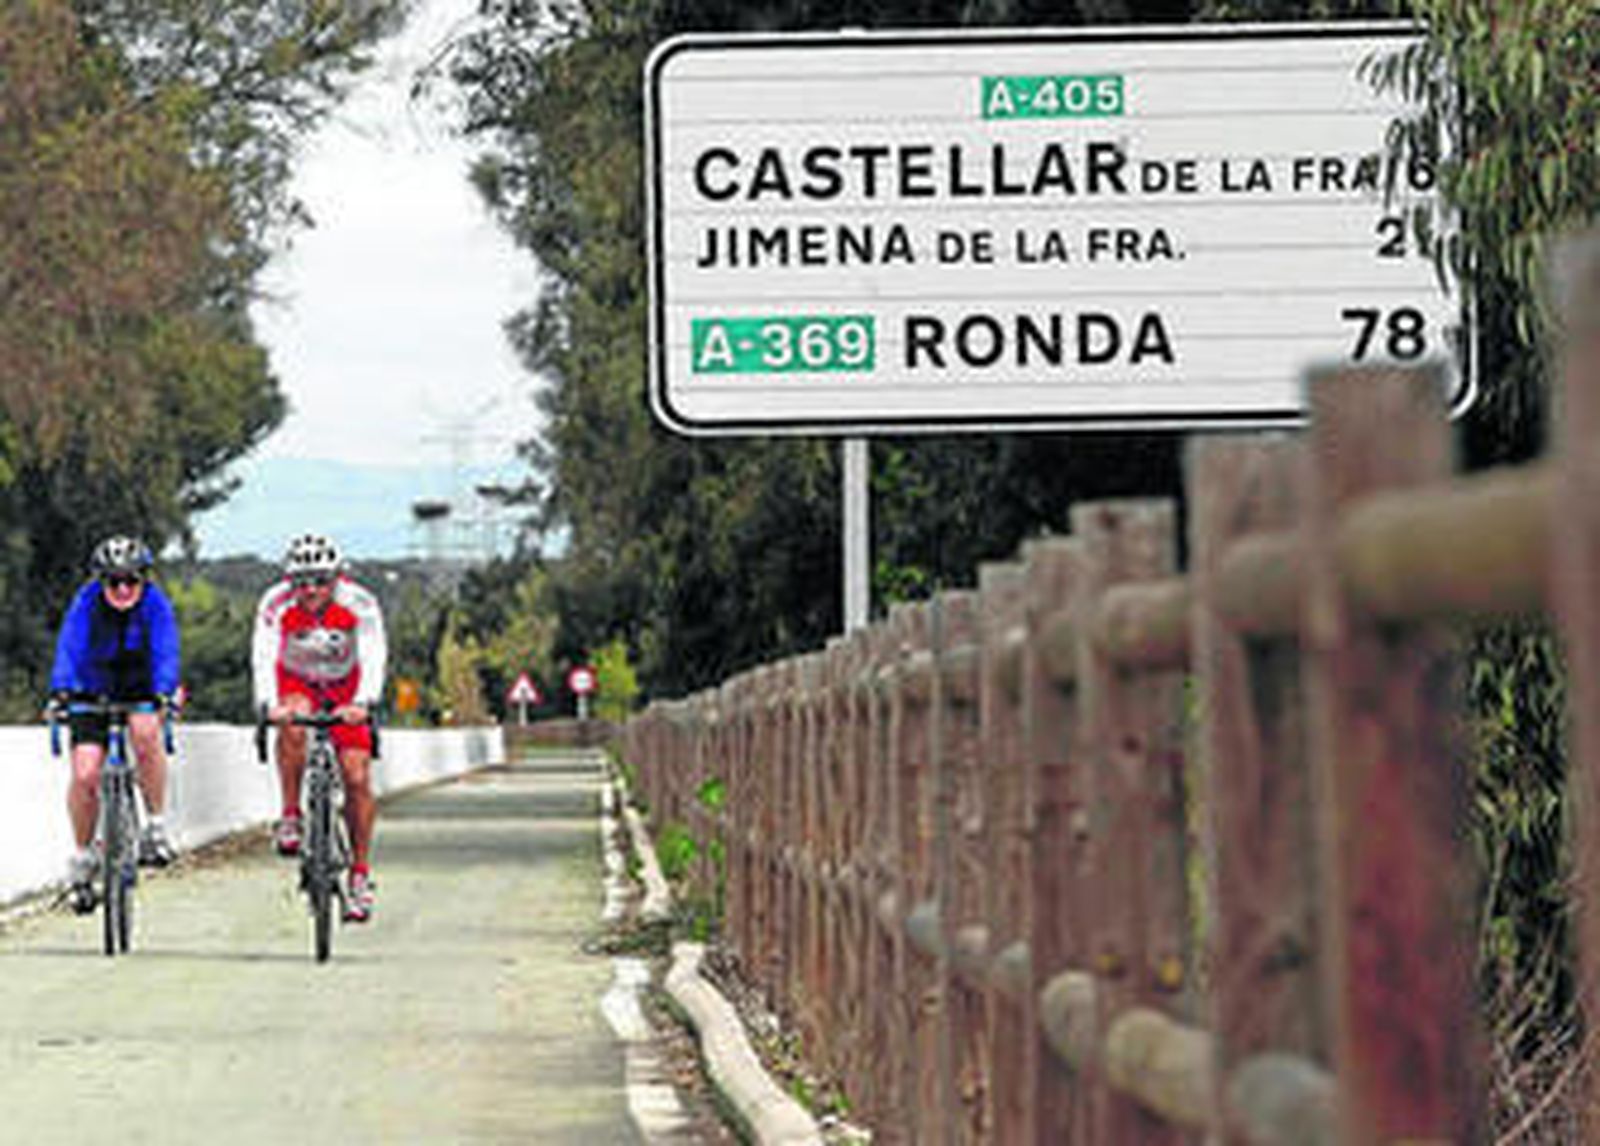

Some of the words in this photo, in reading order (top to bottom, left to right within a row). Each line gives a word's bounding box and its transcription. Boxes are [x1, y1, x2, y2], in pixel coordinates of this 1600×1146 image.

[988, 80, 1121, 116] A-405
[695, 143, 1127, 200] CASTELLAR
[1141, 161, 1198, 193] DE
[1221, 160, 1272, 192] LA
[698, 225, 914, 267] JIMENA
[938, 232, 994, 264] DE
[1016, 231, 1067, 263] LA
[1089, 229, 1185, 261] FRA.
[699, 322, 868, 368] A-369
[906, 313, 1175, 369] RONDA
[1342, 308, 1426, 361] 78
